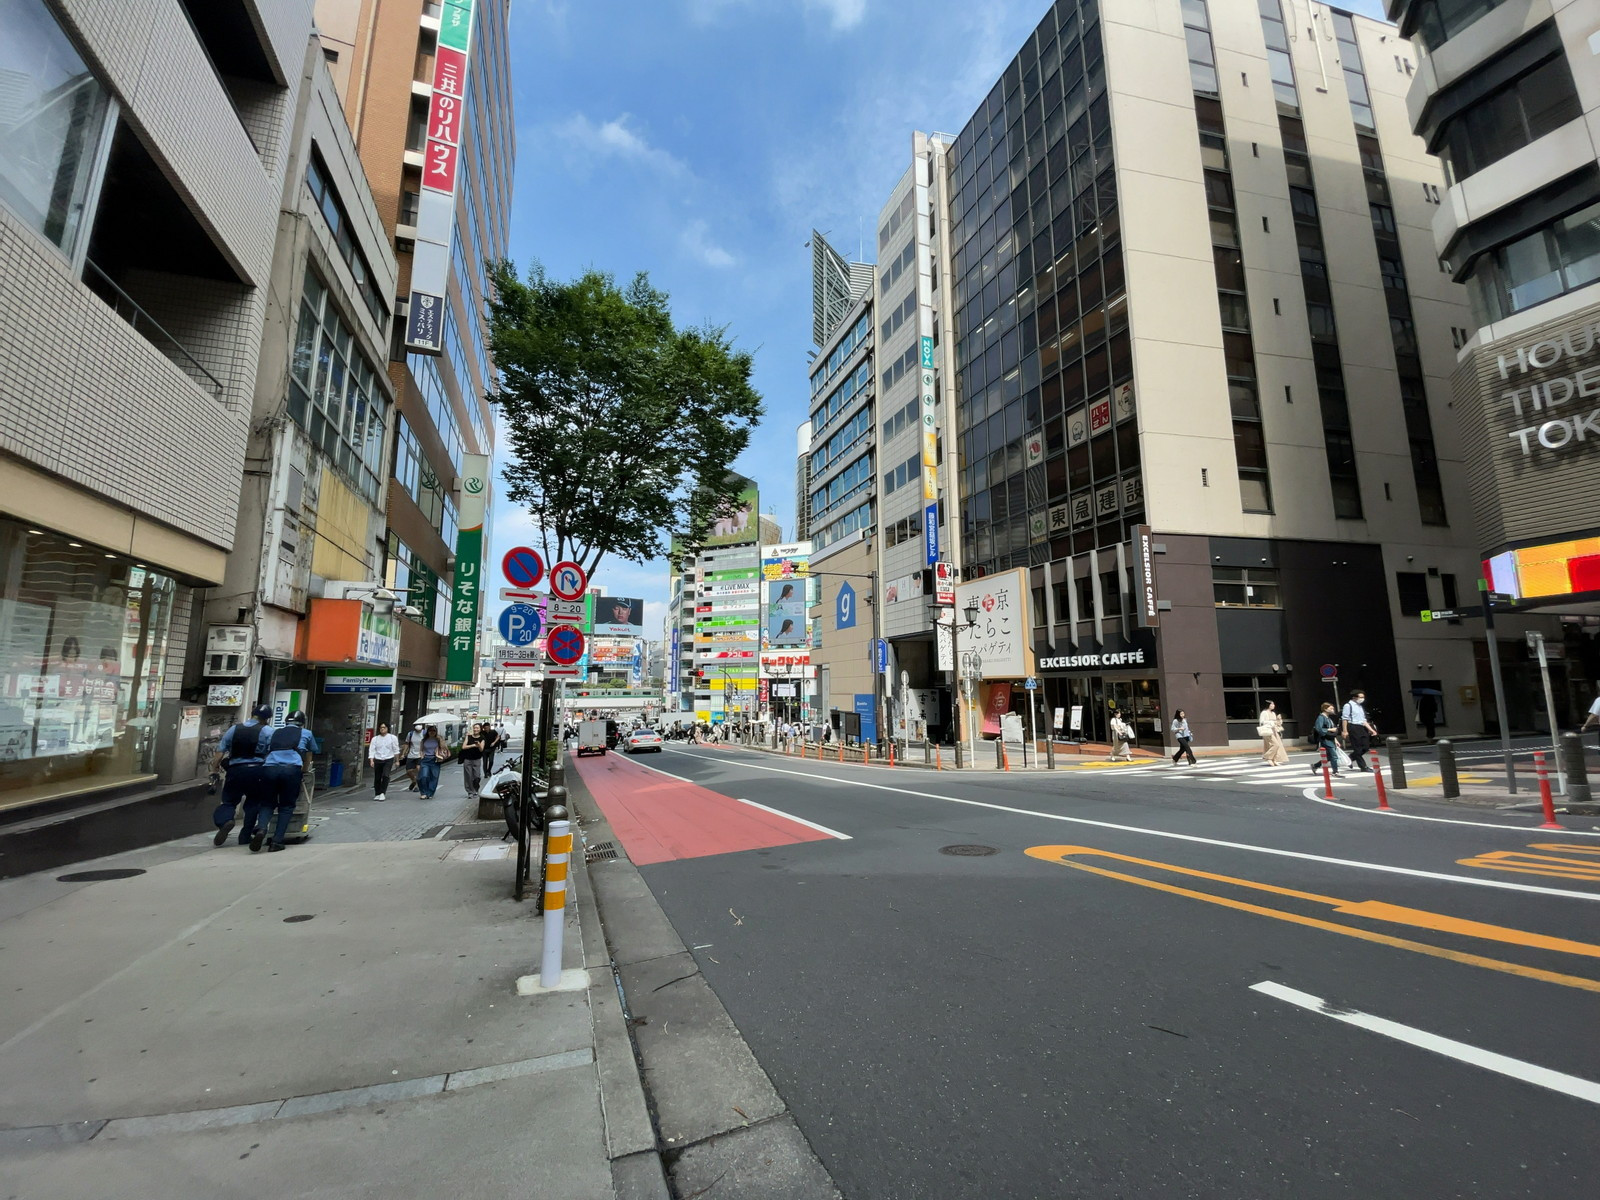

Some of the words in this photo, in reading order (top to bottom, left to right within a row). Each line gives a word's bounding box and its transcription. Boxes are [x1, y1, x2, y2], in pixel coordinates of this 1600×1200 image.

[432, 62, 458, 177] 三井のリハウス
[923, 339, 931, 367] NOVA
[1051, 479, 1143, 528] 東急建設
[1142, 535, 1152, 585] EXCELSIOR
[453, 561, 475, 651] りそな銀行
[511, 605, 534, 616] 9-20
[841, 592, 850, 622] g
[1146, 586, 1156, 617] CAFFÉ
[508, 614, 526, 641] P
[519, 629, 532, 642] 20
[969, 617, 1011, 640] たらこ
[939, 631, 948, 667] スパゲティ
[970, 640, 1012, 656] スパゲティ
[1040, 654, 1101, 669] EXCELSIOR
[1102, 648, 1145, 665] CAFFÉ
